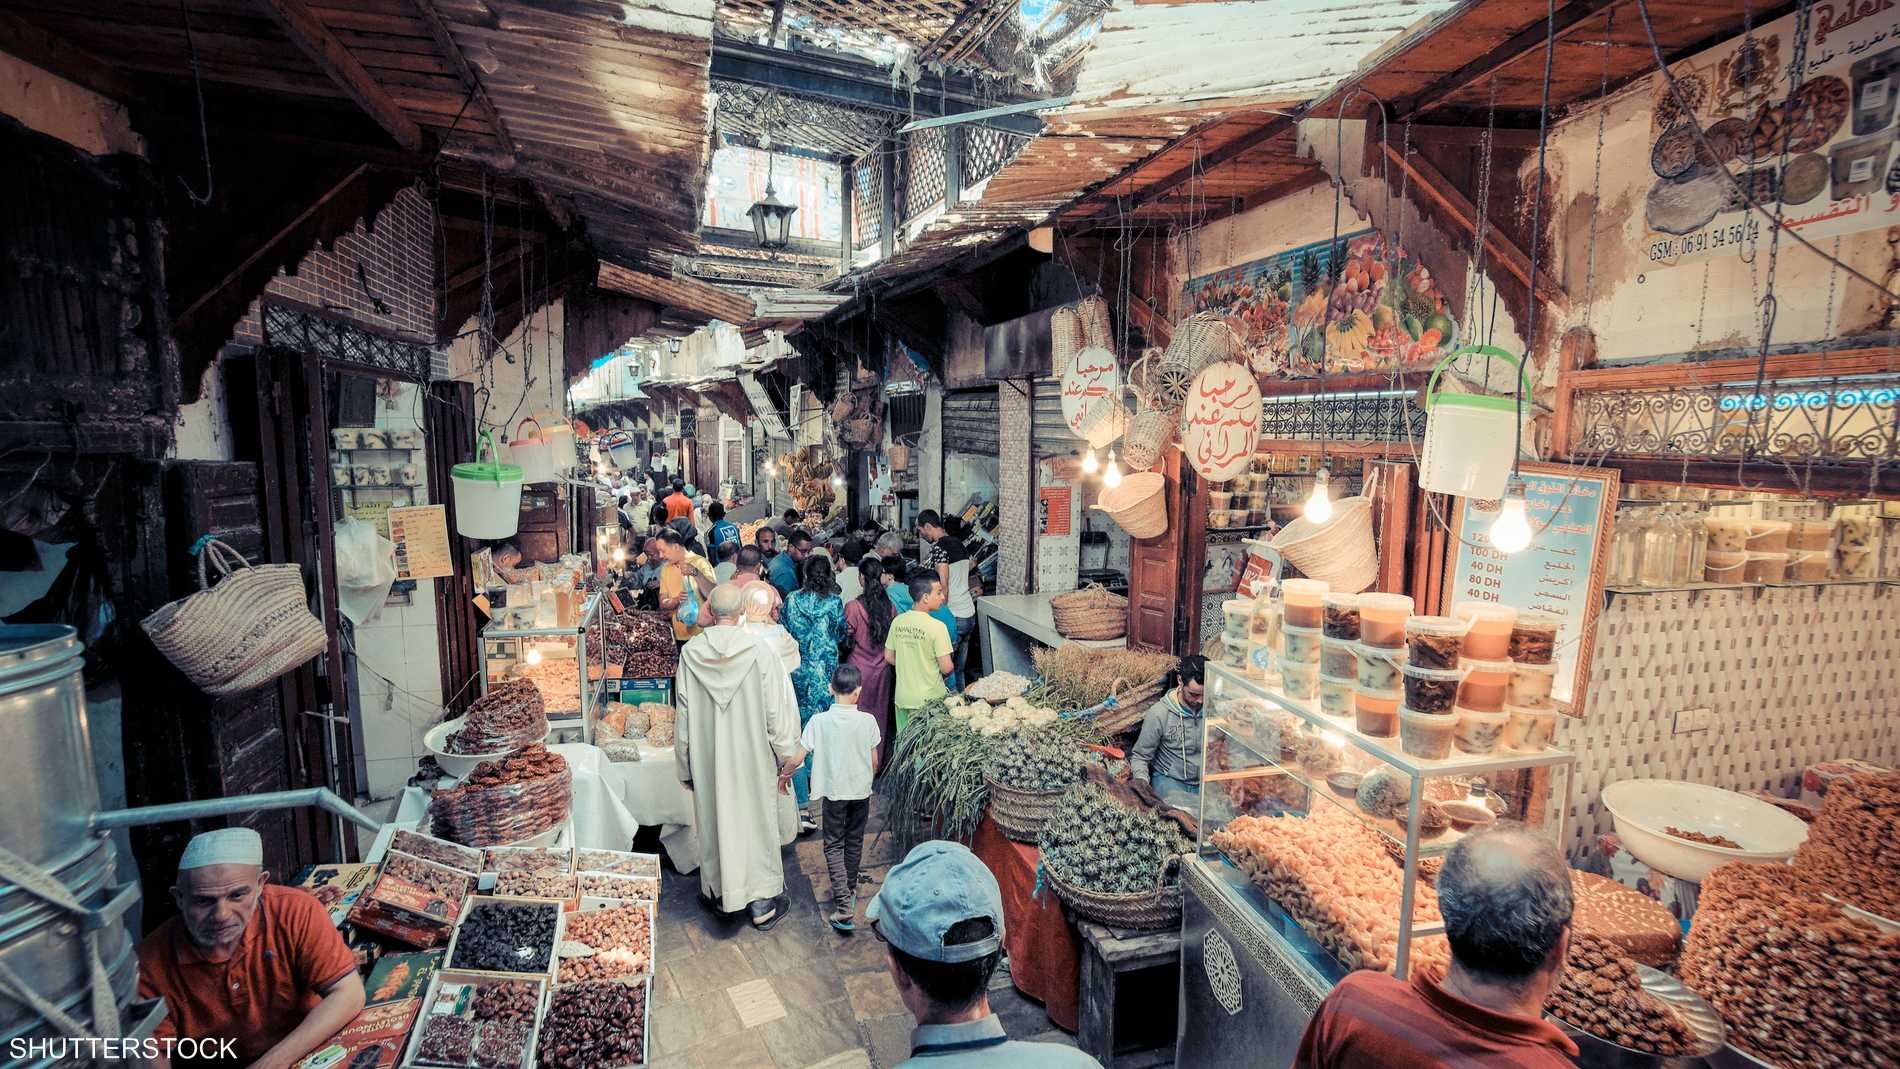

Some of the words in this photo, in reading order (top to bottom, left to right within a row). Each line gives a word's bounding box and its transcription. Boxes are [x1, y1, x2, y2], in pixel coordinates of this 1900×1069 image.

[1650, 241, 1673, 261] GSM
[1681, 236, 1694, 254] 06
[1696, 233, 1708, 252] 91
[1712, 229, 1725, 248] 54
[1076, 357, 1114, 384] مرحبا
[1199, 376, 1254, 407] مرحبا
[1471, 546, 1488, 558] 100
[1471, 561, 1483, 571] 40
[1486, 563, 1503, 574] DH
[1484, 577, 1501, 589] DH
[1467, 588, 1480, 598] 40
[1482, 592, 1499, 603] DH
